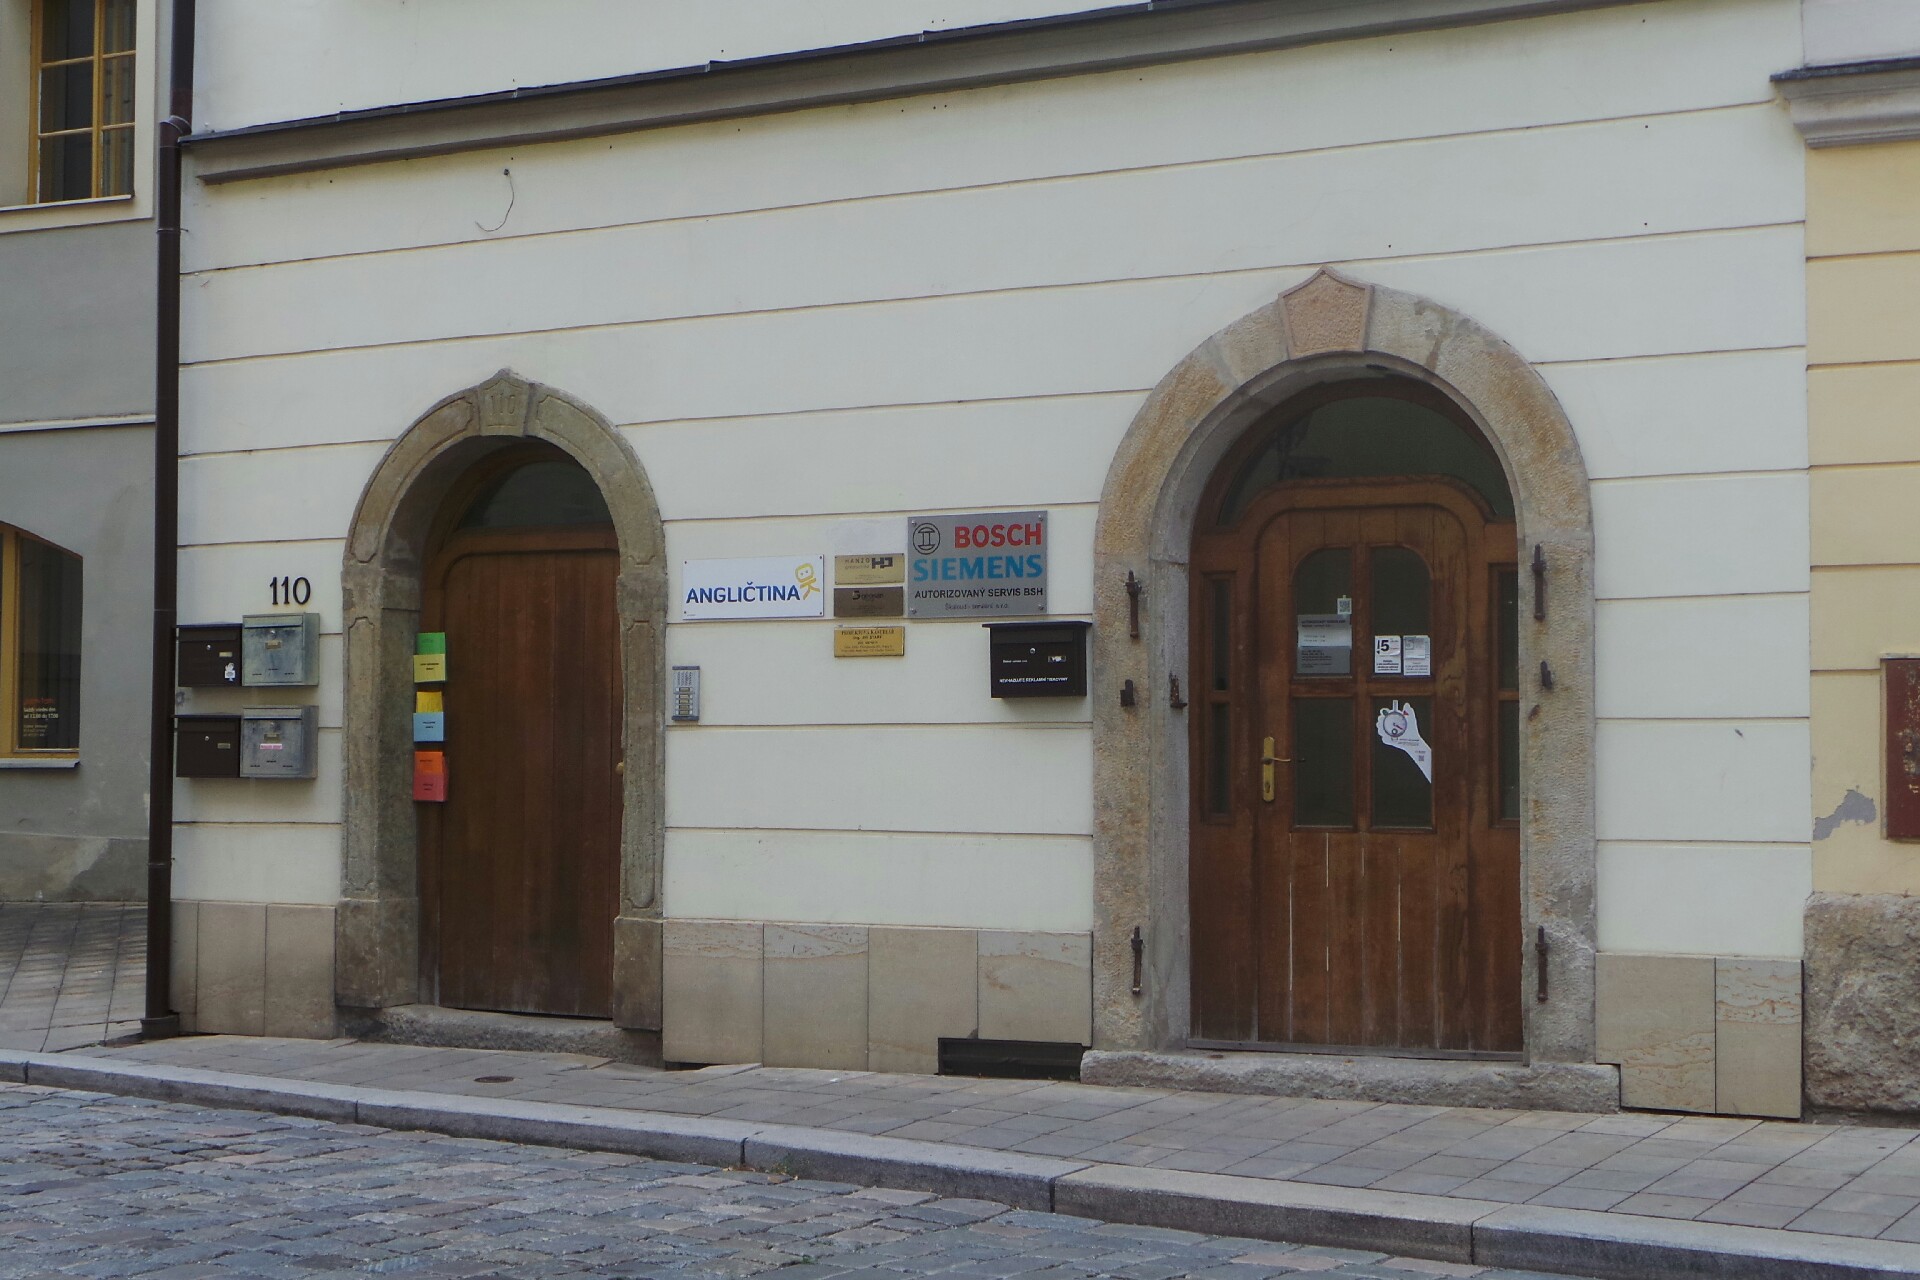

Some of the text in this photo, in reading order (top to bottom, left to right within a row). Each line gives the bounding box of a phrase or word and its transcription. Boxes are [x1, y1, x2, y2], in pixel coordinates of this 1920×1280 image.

[954, 523, 1043, 549] BOSCH
[913, 554, 1044, 582] SIEMENS
[269, 576, 311, 605] 110
[686, 581, 801, 604] ANGLIČTINA
[914, 587, 1044, 599] AUTORIZOVANÝ SERVIS BSH
